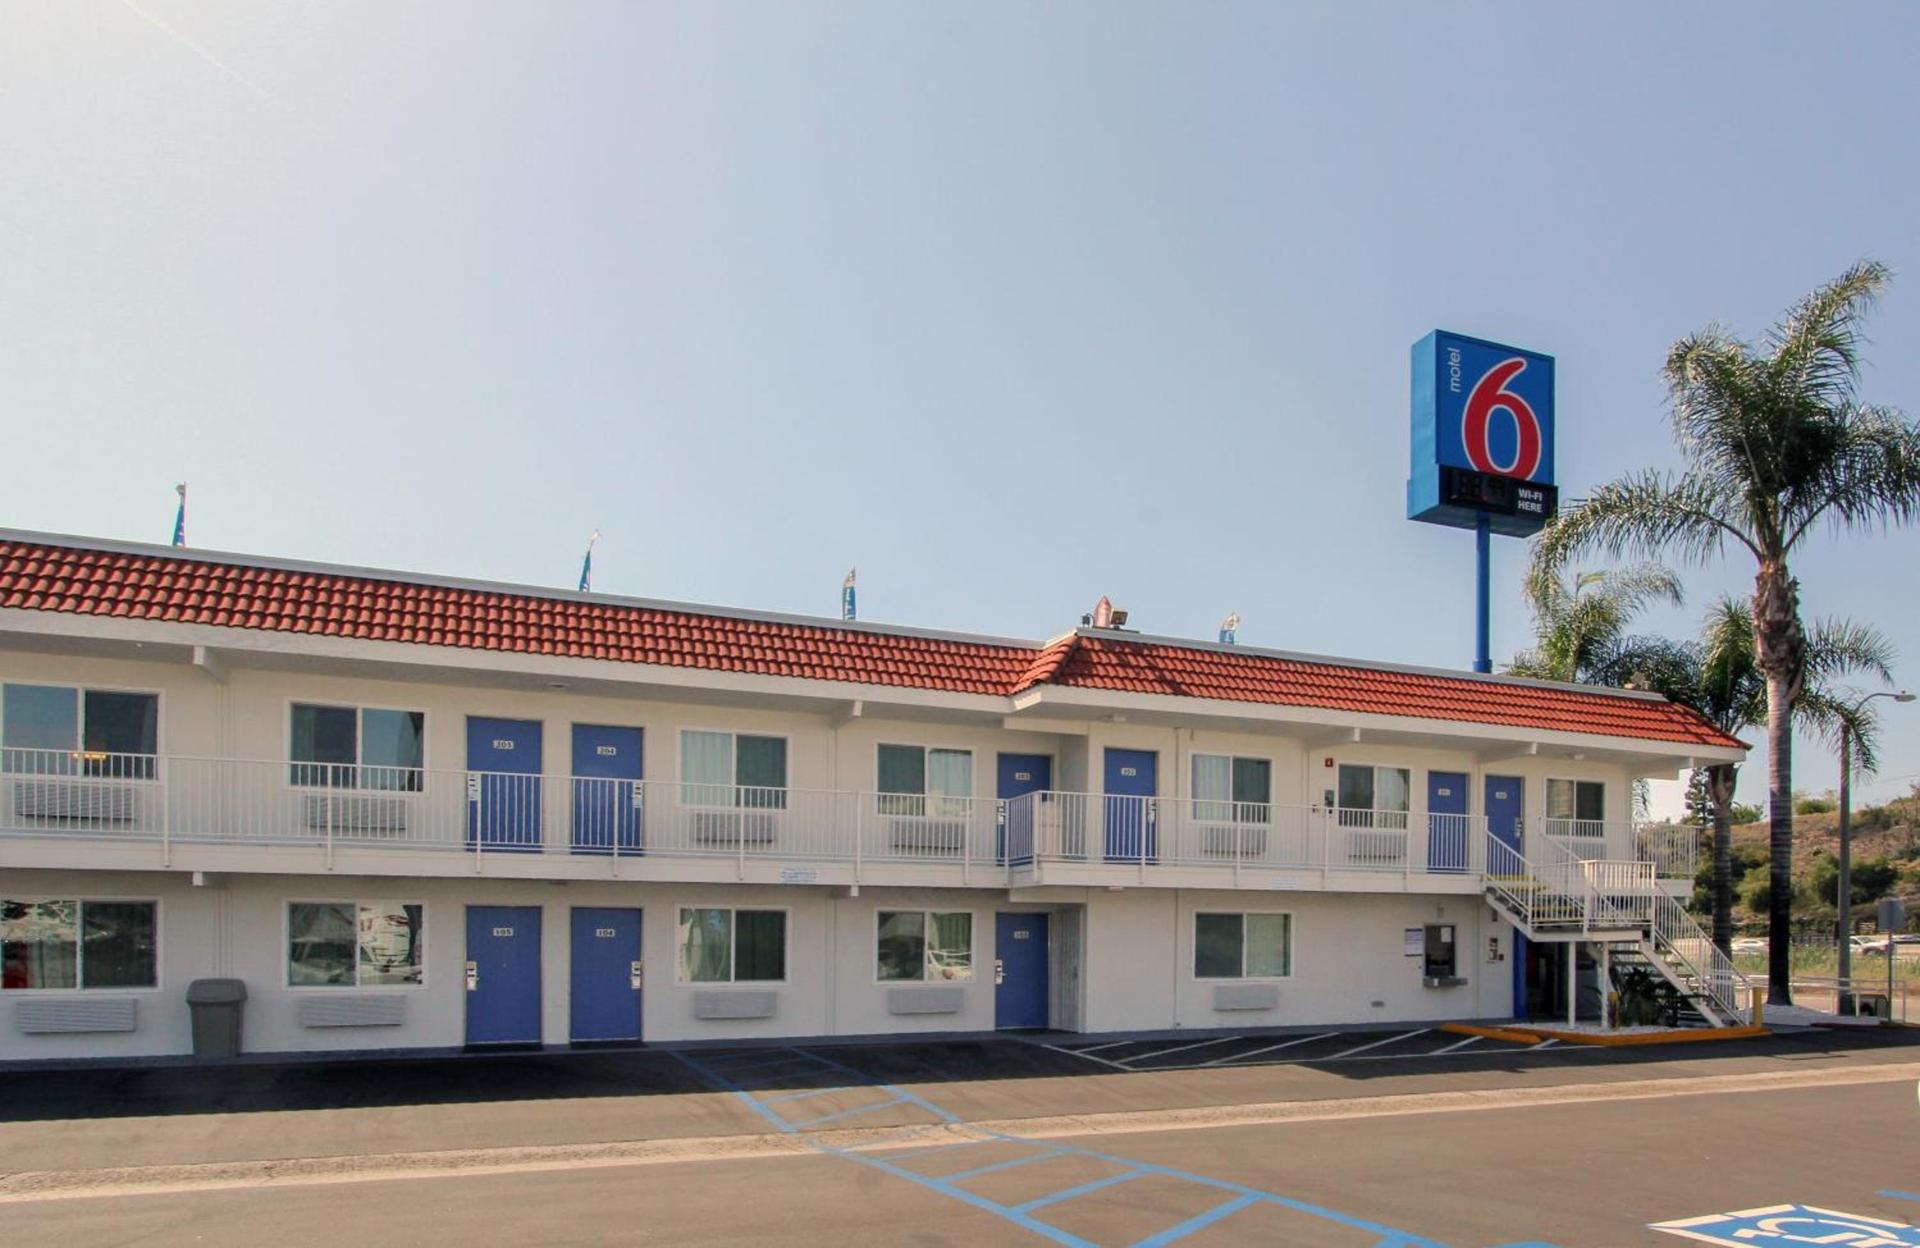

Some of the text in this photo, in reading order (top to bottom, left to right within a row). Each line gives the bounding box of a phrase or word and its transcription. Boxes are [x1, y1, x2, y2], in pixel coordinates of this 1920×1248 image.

[1447, 347, 1461, 392] motel
[1461, 357, 1542, 481] 6
[1518, 488, 1542, 501] WI-FI
[1518, 500, 1542, 513] HERE
[495, 928, 511, 936] 105
[598, 929, 613, 937] 104
